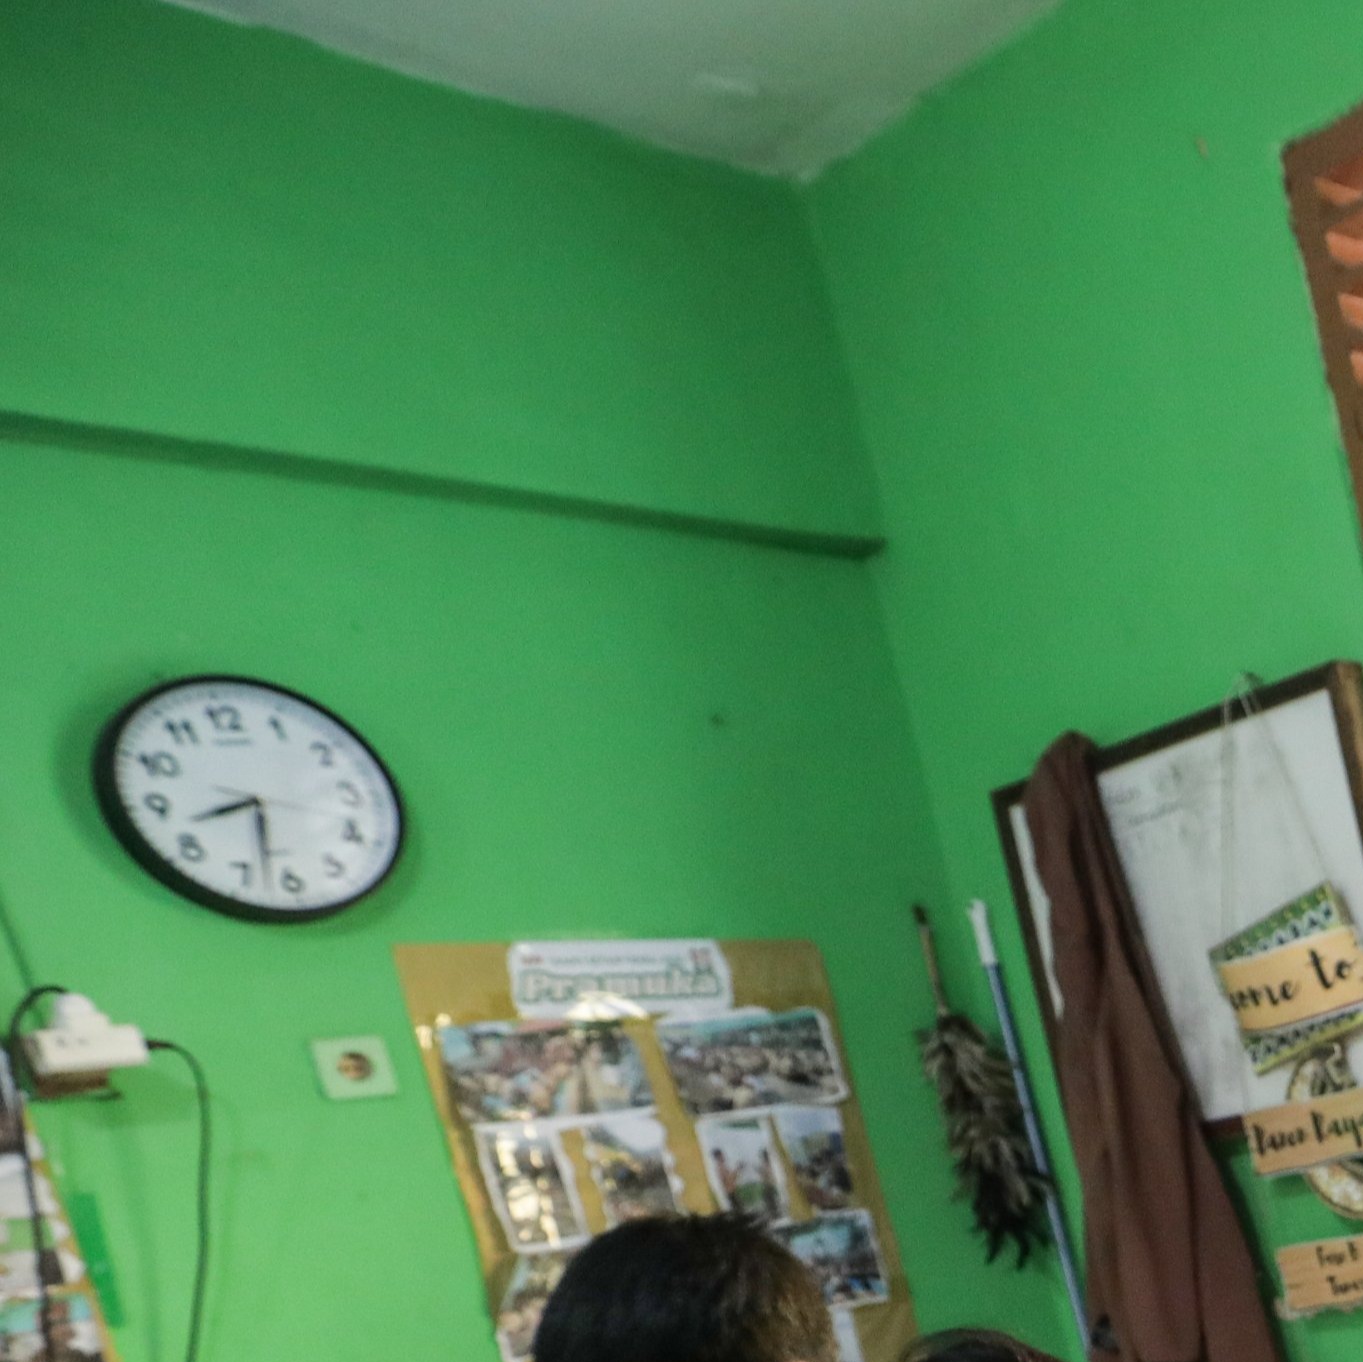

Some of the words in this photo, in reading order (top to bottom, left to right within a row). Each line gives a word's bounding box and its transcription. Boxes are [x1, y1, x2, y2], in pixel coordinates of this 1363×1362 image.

[205, 704, 243, 732] 12
[309, 741, 335, 768] 2
[144, 791, 170, 820] 9
[342, 818, 366, 845] 4
[175, 831, 206, 864] 8
[228, 861, 253, 888] 7
[280, 868, 305, 894] 6
[518, 959, 721, 1002] Pramuka
[1307, 949, 1356, 990] to
